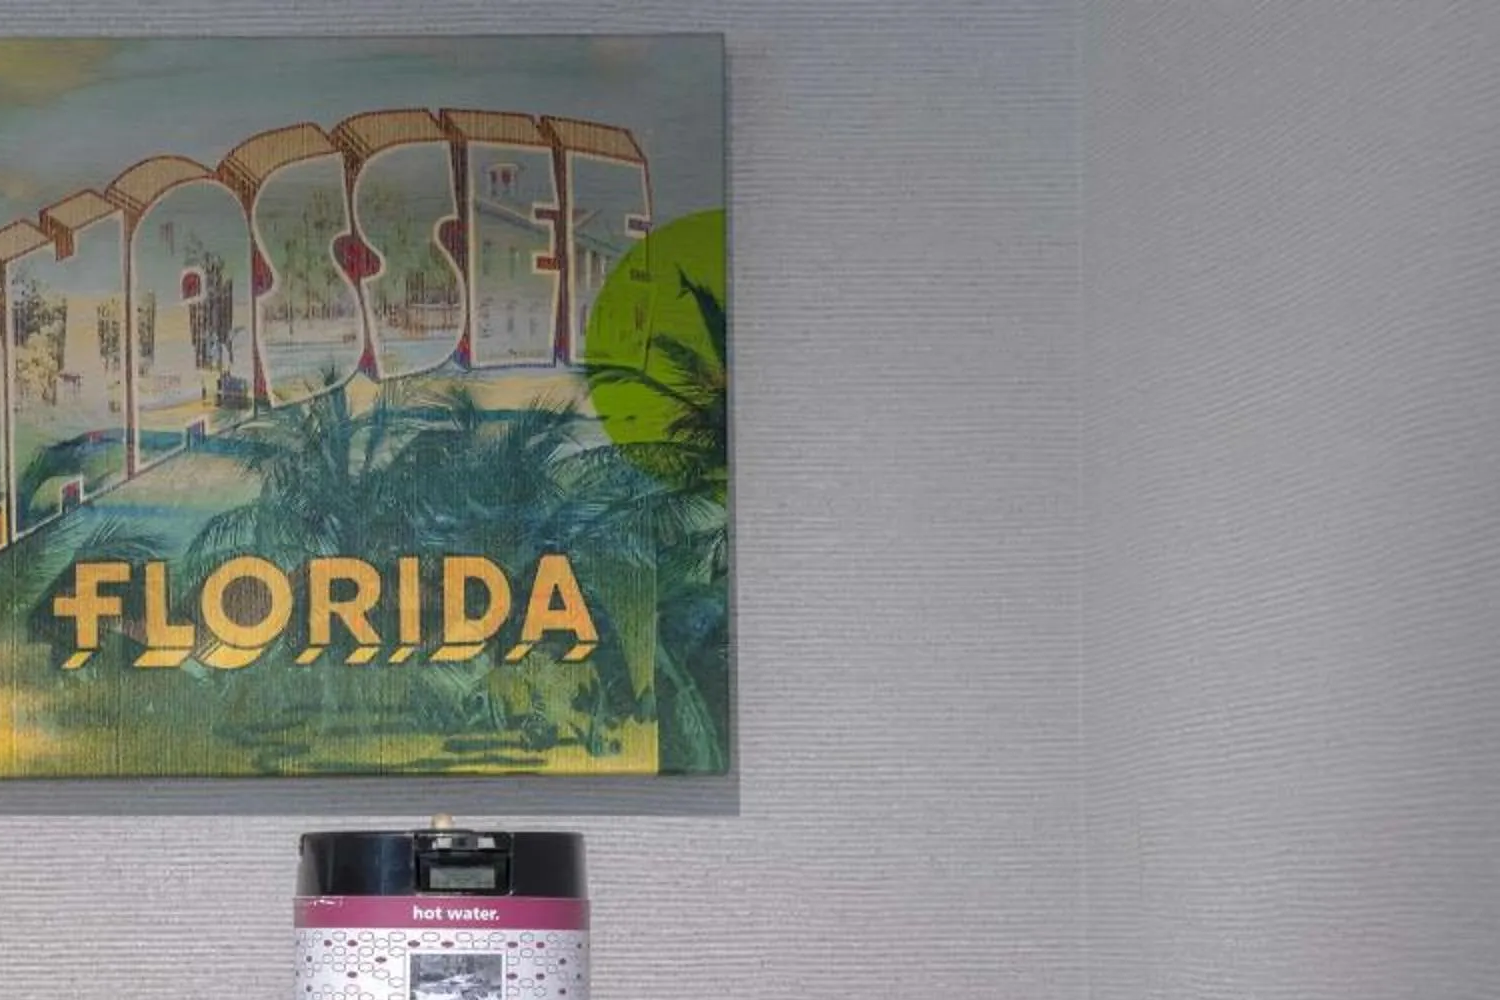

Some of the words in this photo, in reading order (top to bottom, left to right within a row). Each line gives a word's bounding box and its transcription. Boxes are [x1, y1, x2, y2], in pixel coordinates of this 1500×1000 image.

[53, 553, 600, 668] FLORIDA
[413, 905, 442, 920] hot
[448, 906, 500, 920] water.
